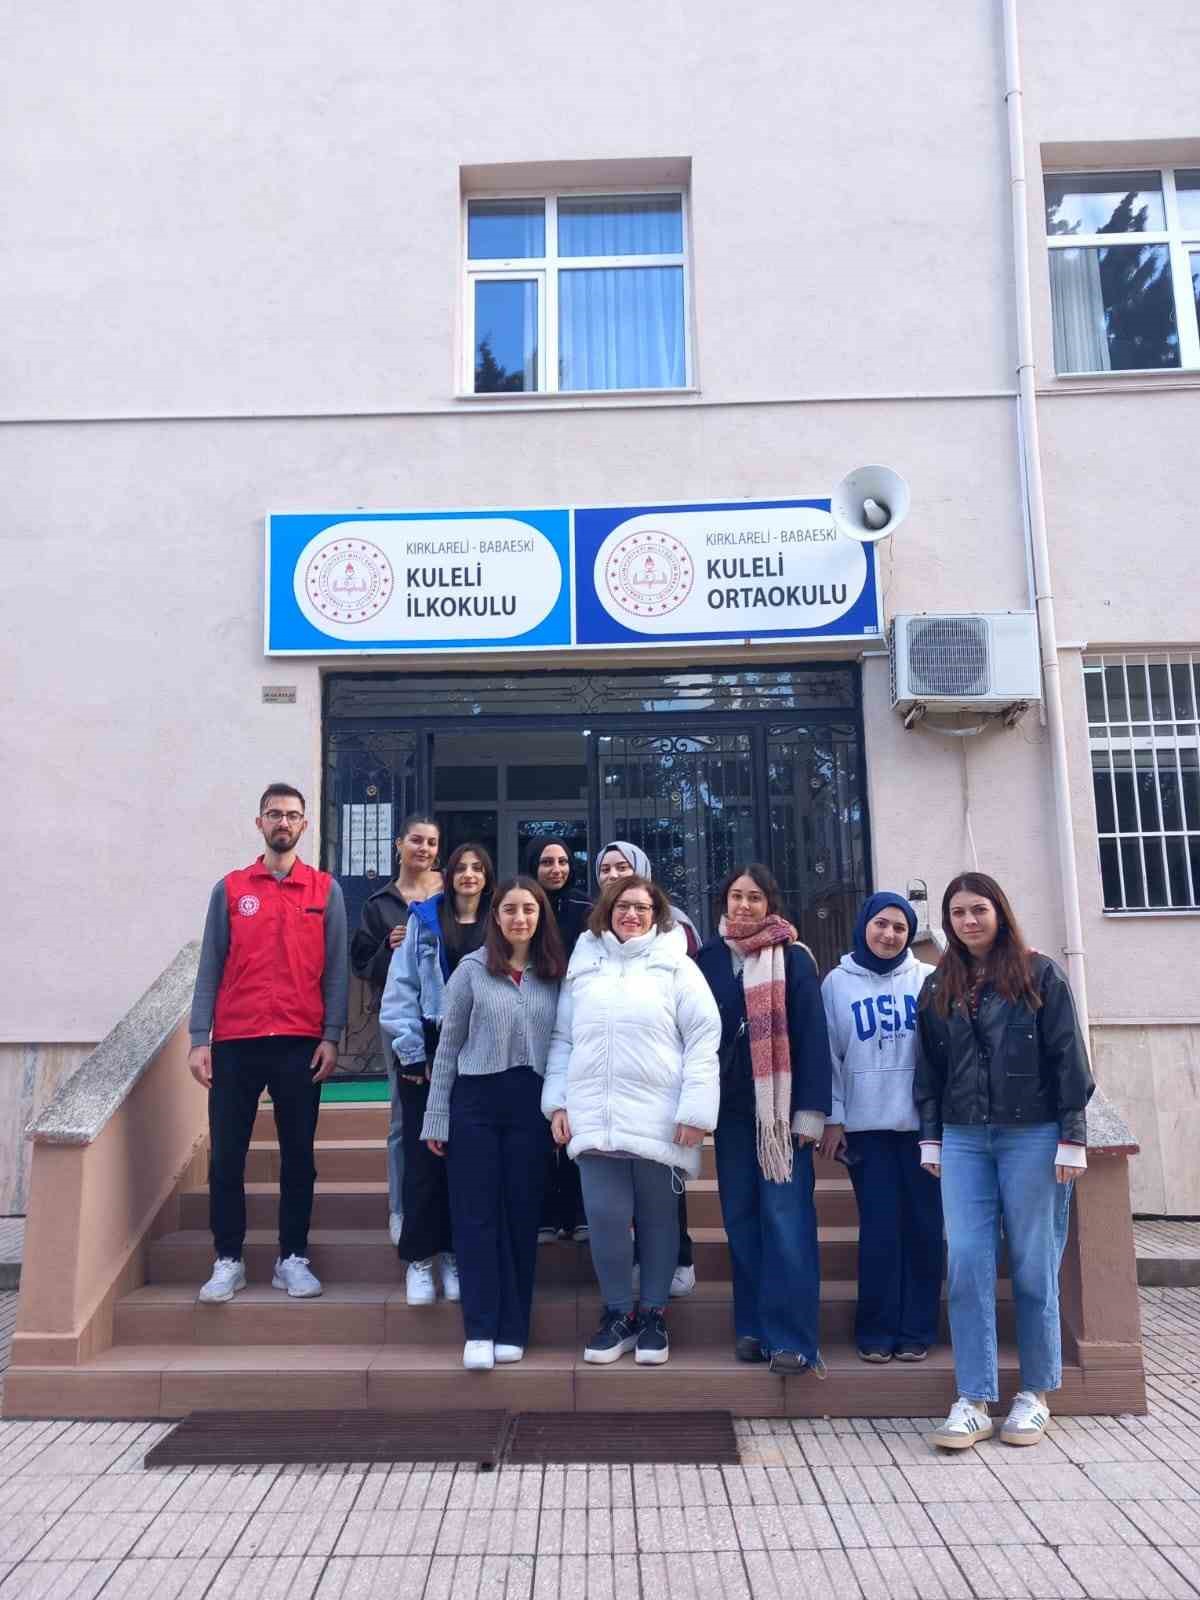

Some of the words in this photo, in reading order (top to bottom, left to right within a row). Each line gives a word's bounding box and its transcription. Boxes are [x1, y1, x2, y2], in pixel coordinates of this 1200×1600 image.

[406, 538, 470, 555] KIRKLARELİ
[479, 537, 535, 554] BABAESKİ
[706, 528, 770, 546] KIRKLARELİ
[780, 527, 837, 543] BABAESKİ
[407, 562, 482, 588] KULELİ
[707, 552, 784, 580] KULELİ
[407, 593, 517, 618] İLKOKULU
[707, 583, 847, 609] ORTAOKULU
